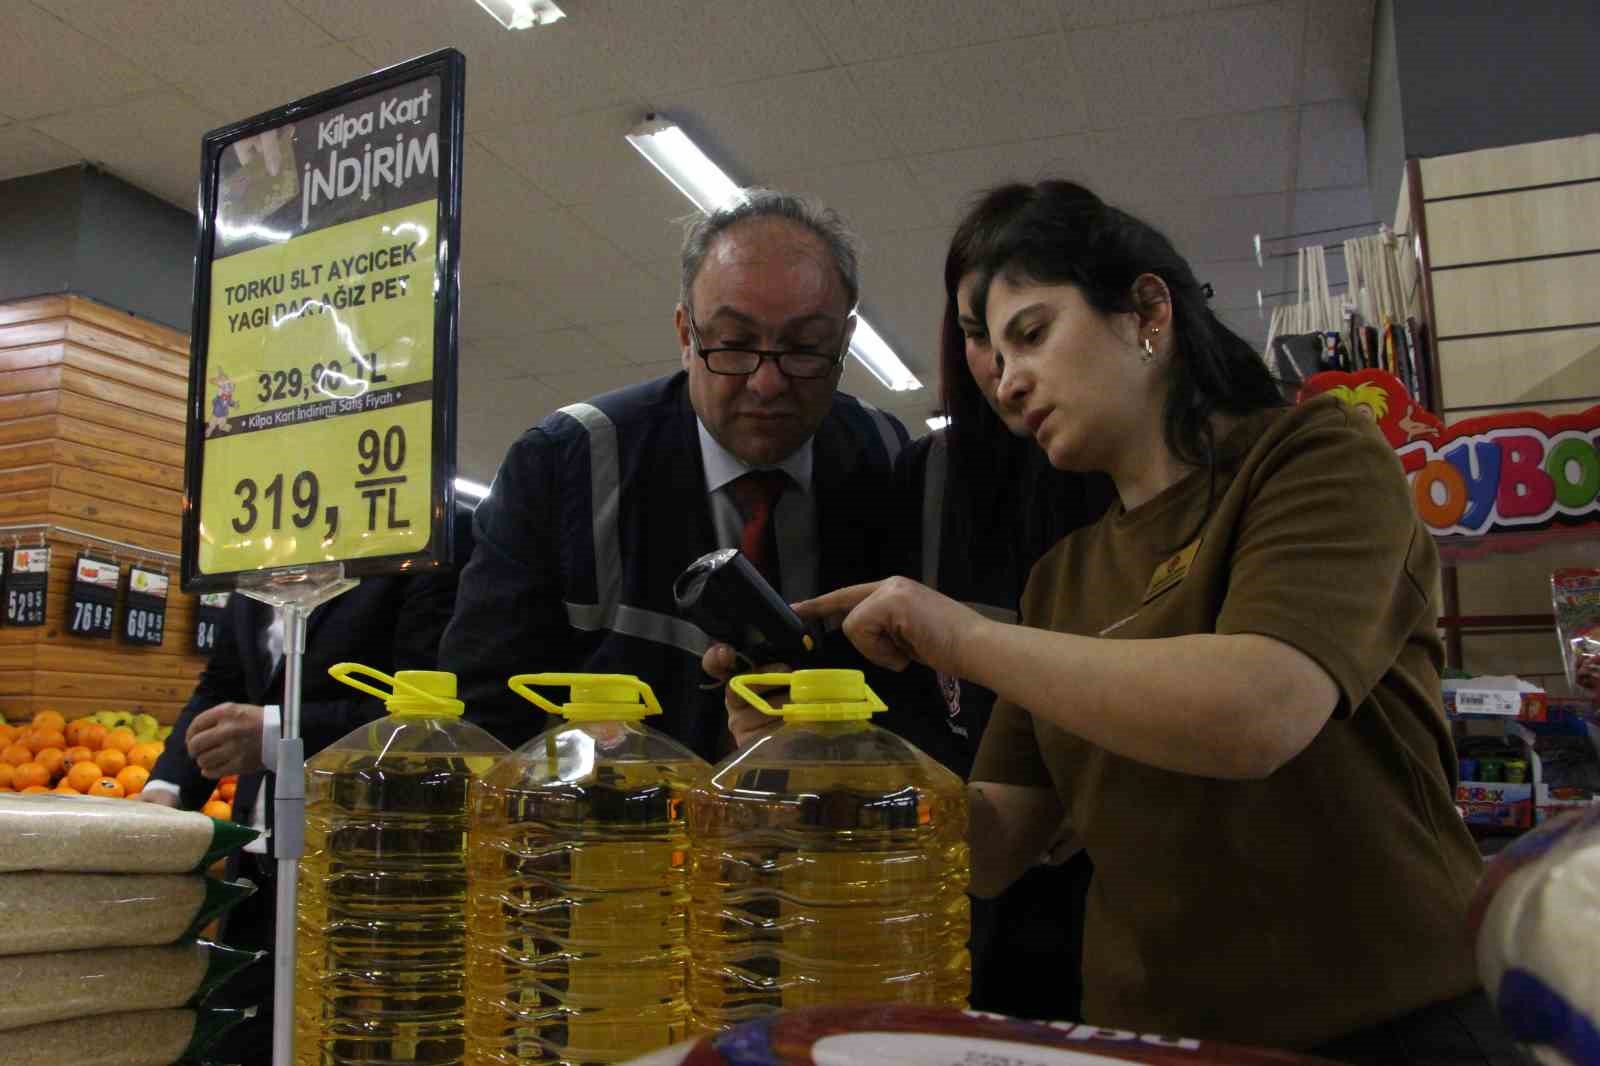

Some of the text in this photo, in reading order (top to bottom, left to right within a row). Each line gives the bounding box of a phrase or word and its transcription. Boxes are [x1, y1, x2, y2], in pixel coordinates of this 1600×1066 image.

[318, 88, 432, 150] Kilpa Kart
[225, 242, 417, 306] TORKU 5LT AYCICEK
[228, 307, 269, 333] YAGI
[371, 275, 410, 302] PET
[248, 416, 273, 429] Kilpa
[275, 410, 295, 423] Kart
[358, 425, 406, 475] 90
[361, 488, 410, 531] TL
